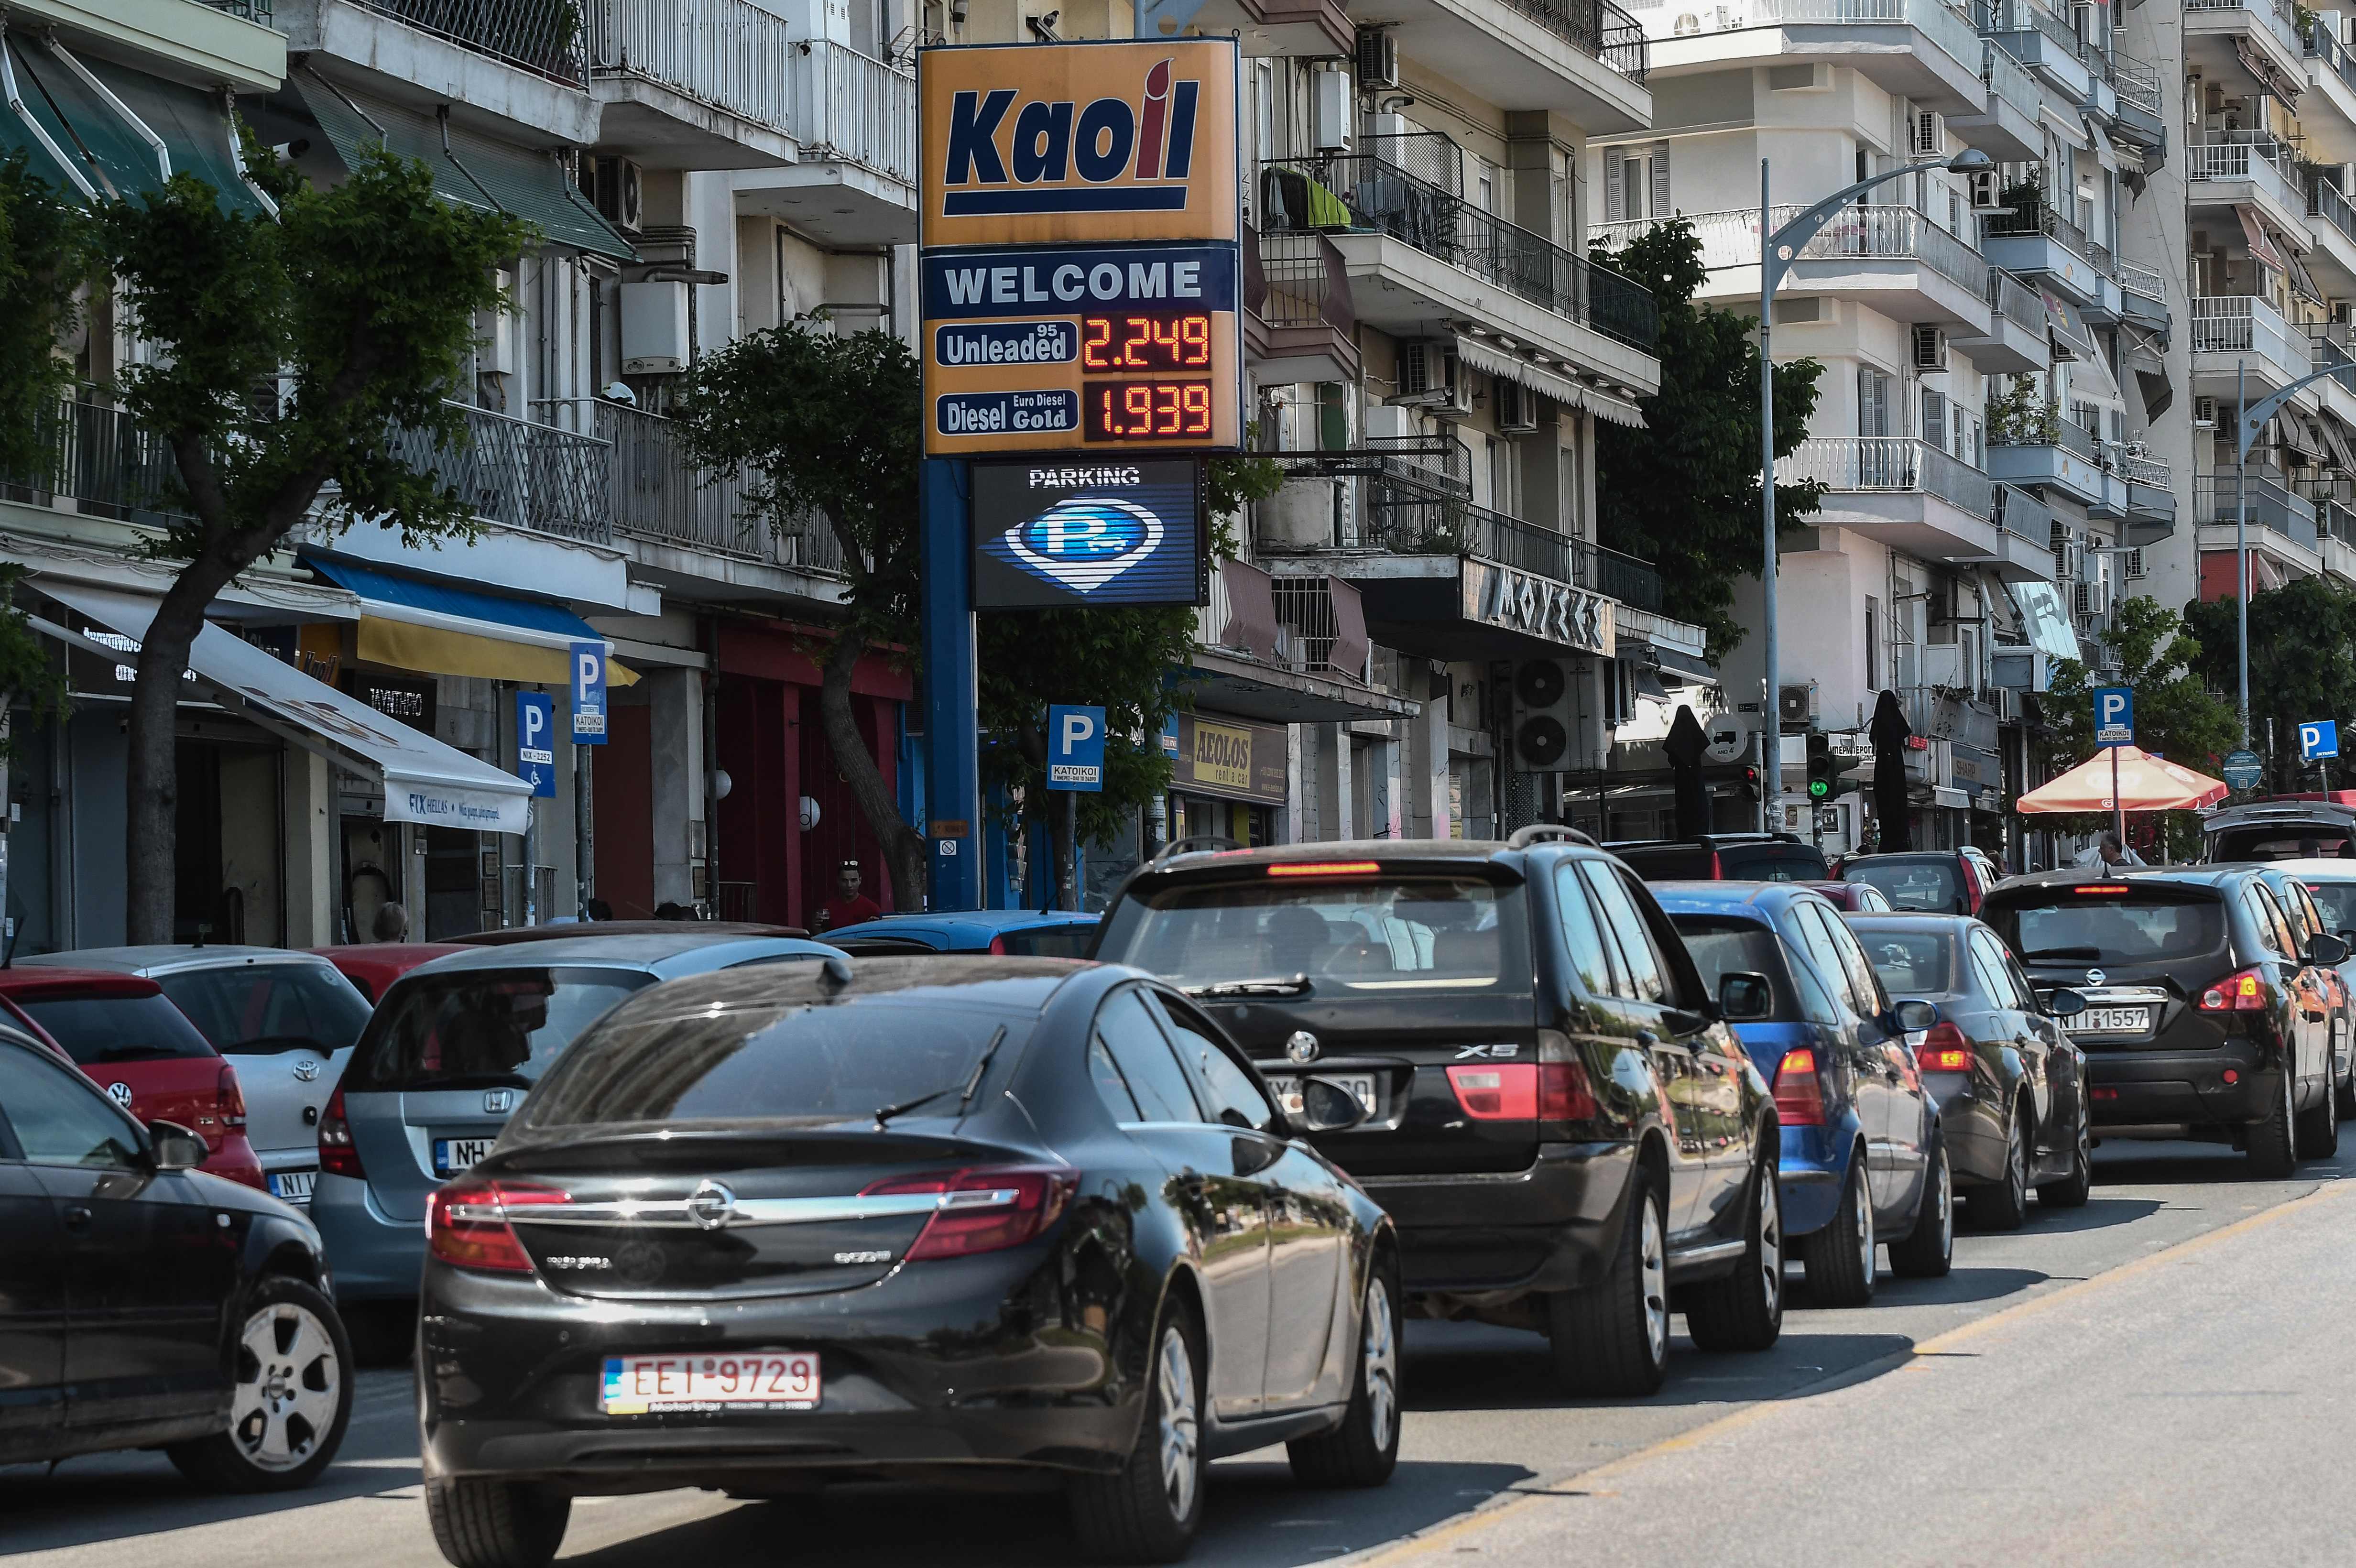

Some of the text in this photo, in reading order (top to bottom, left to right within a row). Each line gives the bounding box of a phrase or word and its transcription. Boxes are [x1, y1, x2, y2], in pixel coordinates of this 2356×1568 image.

[944, 57, 1200, 185] Kaoil
[945, 261, 1202, 305] WELCOME
[1037, 324, 1058, 337] 95
[1084, 316, 1209, 367] 2.249
[946, 331, 1067, 363] Unleaded
[1013, 392, 1066, 407] Euro Diesel
[1103, 385, 1209, 434] 1.939
[947, 401, 1006, 431] Diesel
[1013, 408, 1068, 429] Gold
[1029, 467, 1141, 488] PARKING
[578, 653, 600, 702] P
[576, 716, 603, 726] ΚΑΤΟΙΚΟΙ
[2104, 695, 2125, 723] P
[525, 705, 544, 746] P
[1062, 714, 1094, 755] P
[1196, 730, 1249, 770] AEOLOS
[2301, 727, 2320, 757] P
[537, 752, 550, 762] 2252
[1956, 760, 1975, 778] SHARP
[1054, 766, 1096, 776] ΚΑΤΟΙΚΟΙ
[1215, 769, 1229, 781] rent
[1238, 773, 1248, 785] car
[409, 793, 427, 815] FIX
[427, 798, 448, 814] HELLAS
[1454, 1044, 1519, 1059] X5
[457, 1141, 494, 1165] NH
